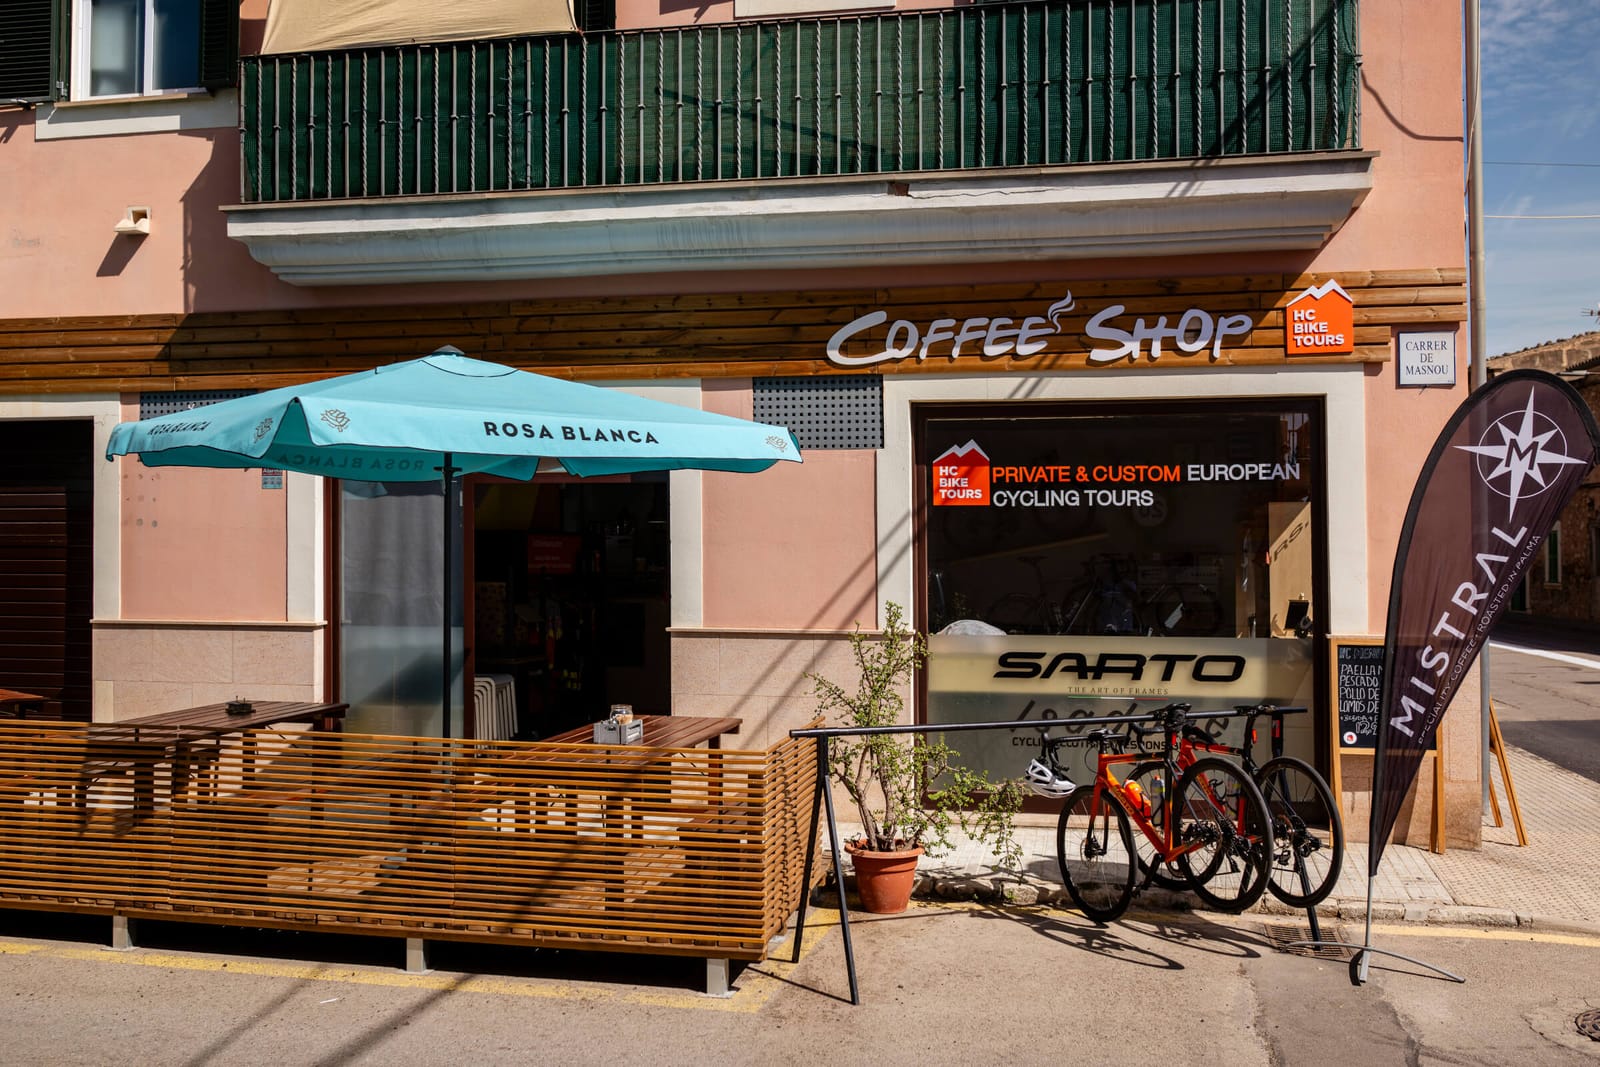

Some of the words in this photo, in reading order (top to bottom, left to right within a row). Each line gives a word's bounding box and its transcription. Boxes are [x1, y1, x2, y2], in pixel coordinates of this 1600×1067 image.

[1293, 309, 1316, 321] HC
[1294, 322, 1328, 333] BIKE
[1294, 334, 1345, 346] TOURS
[1405, 340, 1448, 351] CARRER
[1420, 352, 1434, 363] DE
[1405, 364, 1449, 376] MASNOU
[483, 421, 554, 439] ROSA
[561, 425, 660, 444] BLANCA
[939, 466, 959, 476] HC
[992, 465, 1071, 483] PRIVATE
[1075, 465, 1090, 482] &
[1093, 465, 1181, 482] CUSTOM
[1187, 463, 1300, 481] EUROPEAN
[939, 477, 968, 487] BIKE
[939, 488, 983, 499] TOURS
[993, 489, 1080, 507] CYCLING
[1084, 489, 1154, 506] TOURS
[1451, 638, 1475, 681] COFFEE
[1477, 583, 1509, 633] ROASTED
[1507, 569, 1518, 582] IN
[1515, 535, 1541, 570] PALMA
[1389, 526, 1528, 738] MISTRAL
[993, 651, 1247, 682] SARTO
[1340, 664, 1376, 676] PAELLA
[1339, 675, 1379, 687] PESCADO
[1068, 686, 1086, 694] THE
[1129, 687, 1169, 695] FRAMES
[1339, 687, 1366, 700] POLLO
[1368, 688, 1380, 701] DE
[1339, 700, 1366, 712] LOMOS
[1367, 700, 1380, 714] DE
